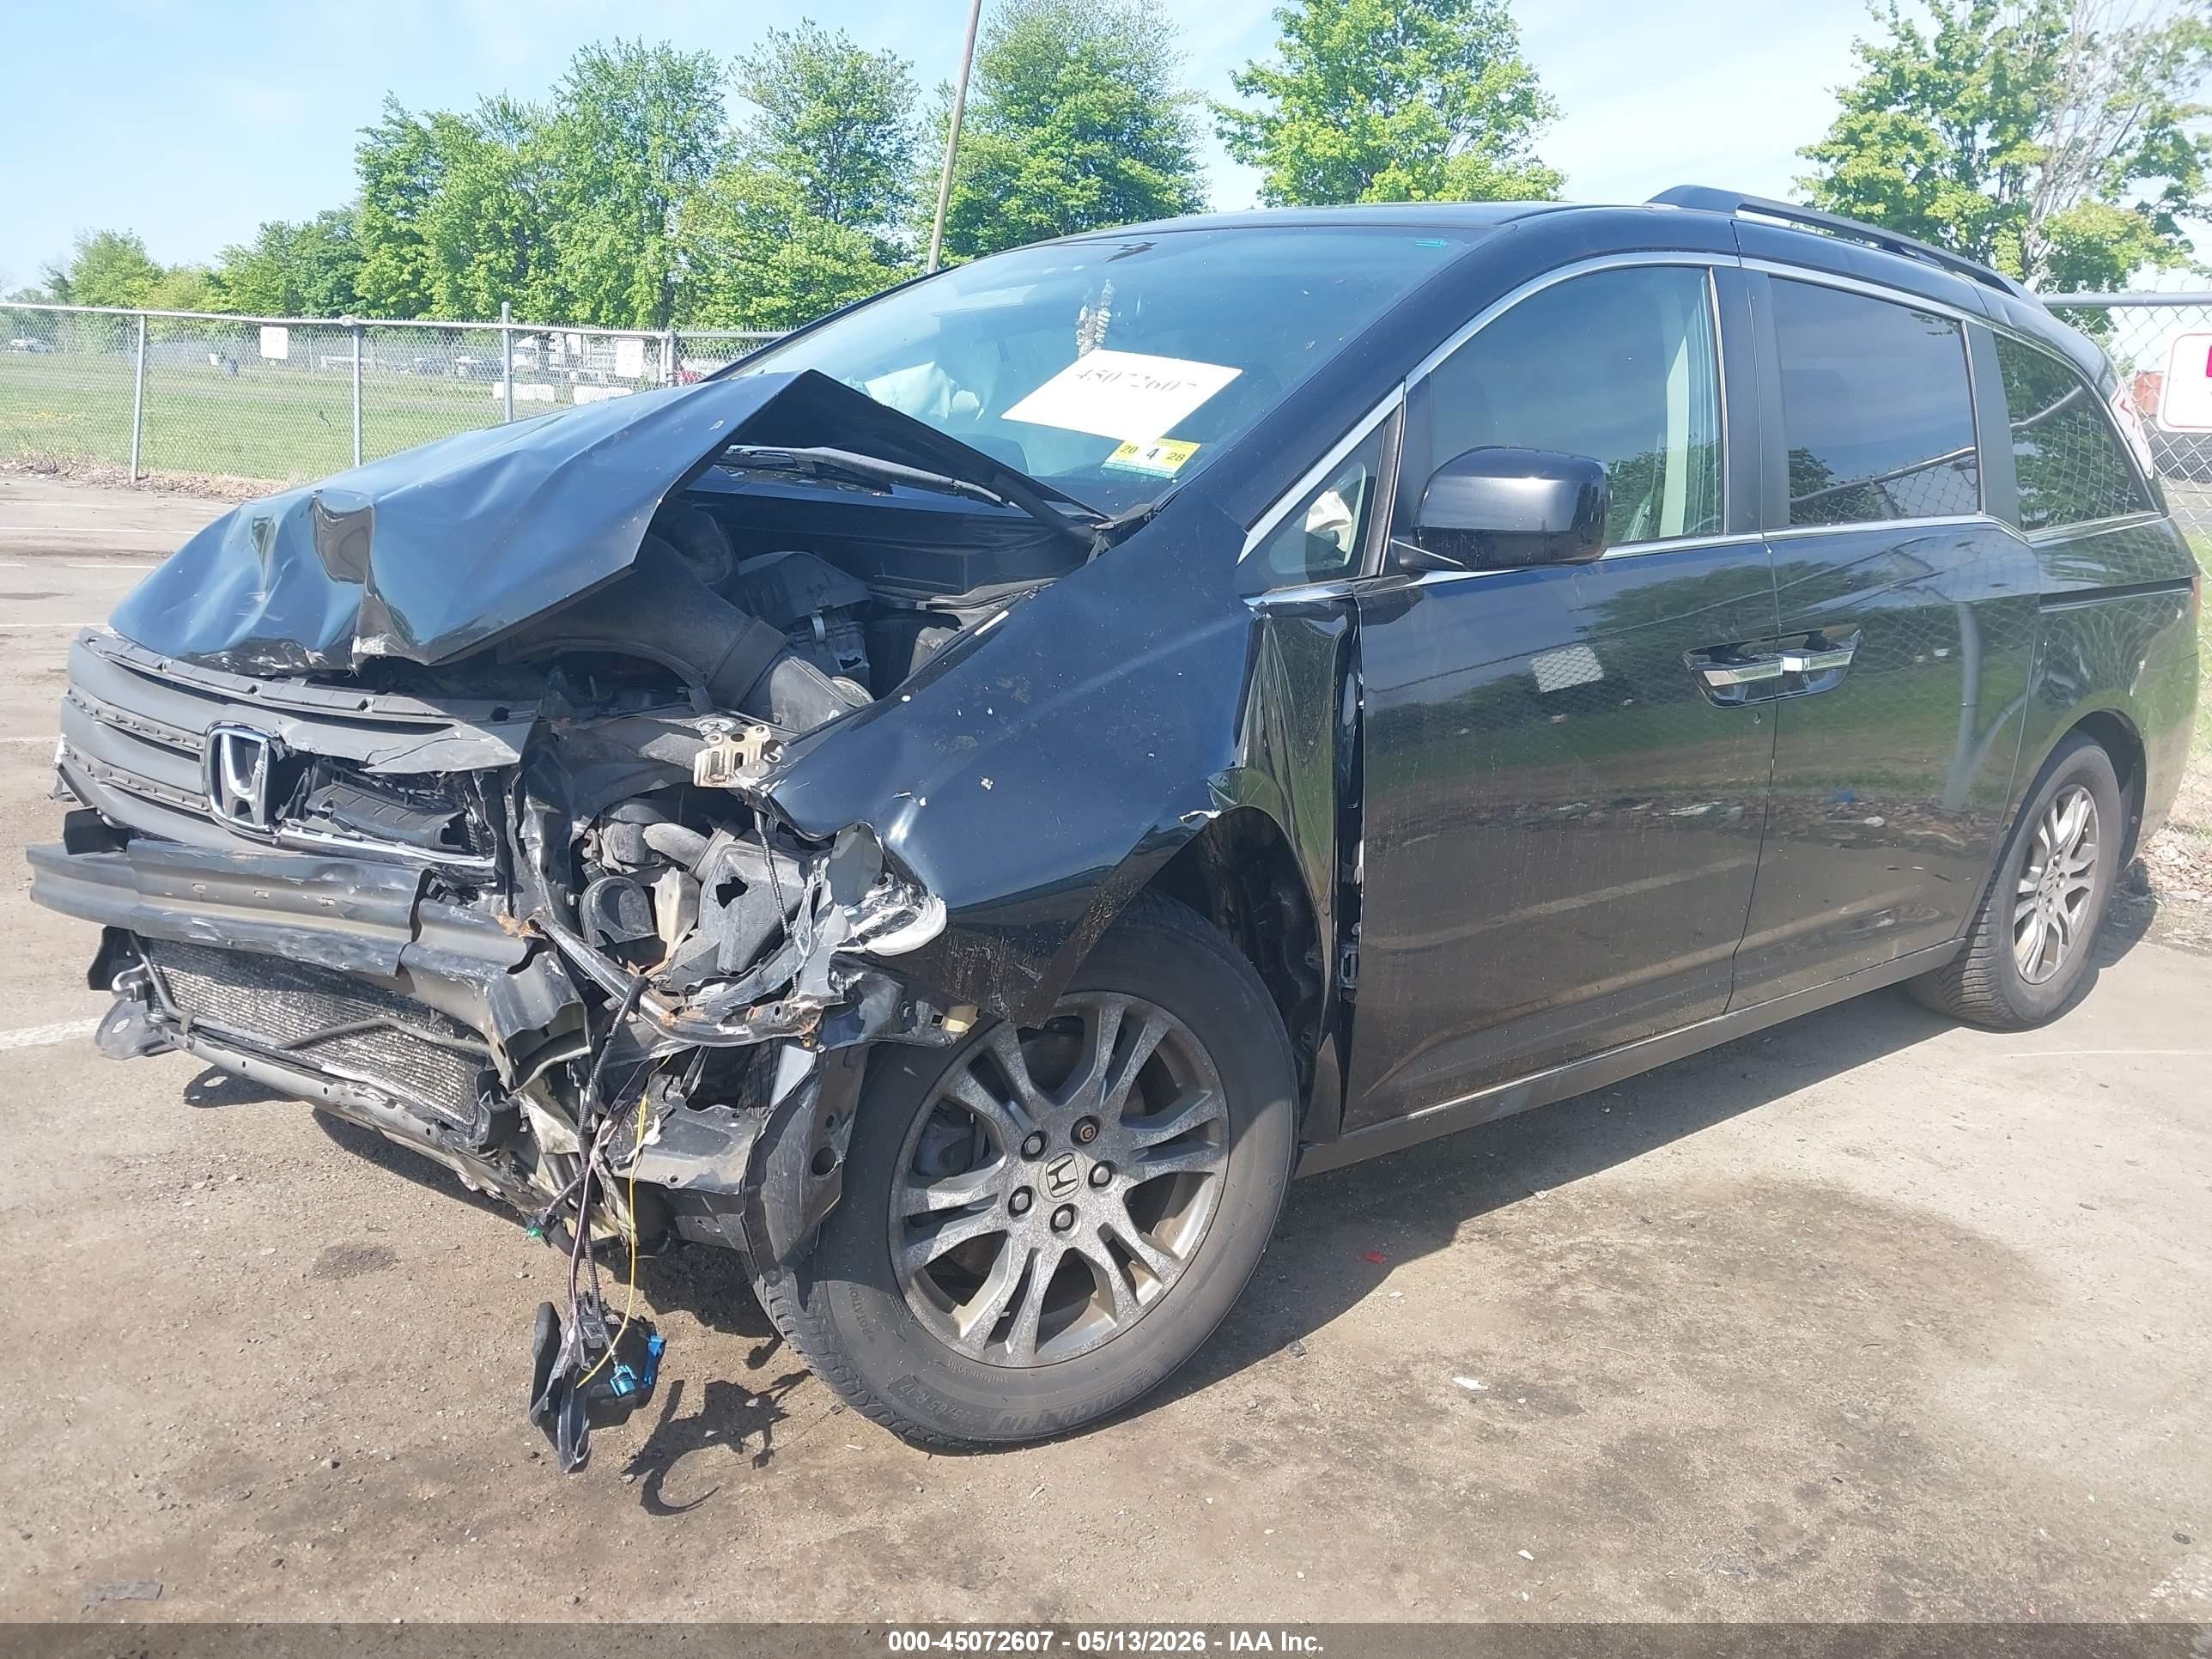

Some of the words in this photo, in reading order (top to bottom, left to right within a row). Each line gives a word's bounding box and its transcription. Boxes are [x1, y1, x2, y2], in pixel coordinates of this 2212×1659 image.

[1120, 444, 1139, 455] 20
[1146, 447, 1160, 460] 4
[1165, 452, 1187, 463] 28
